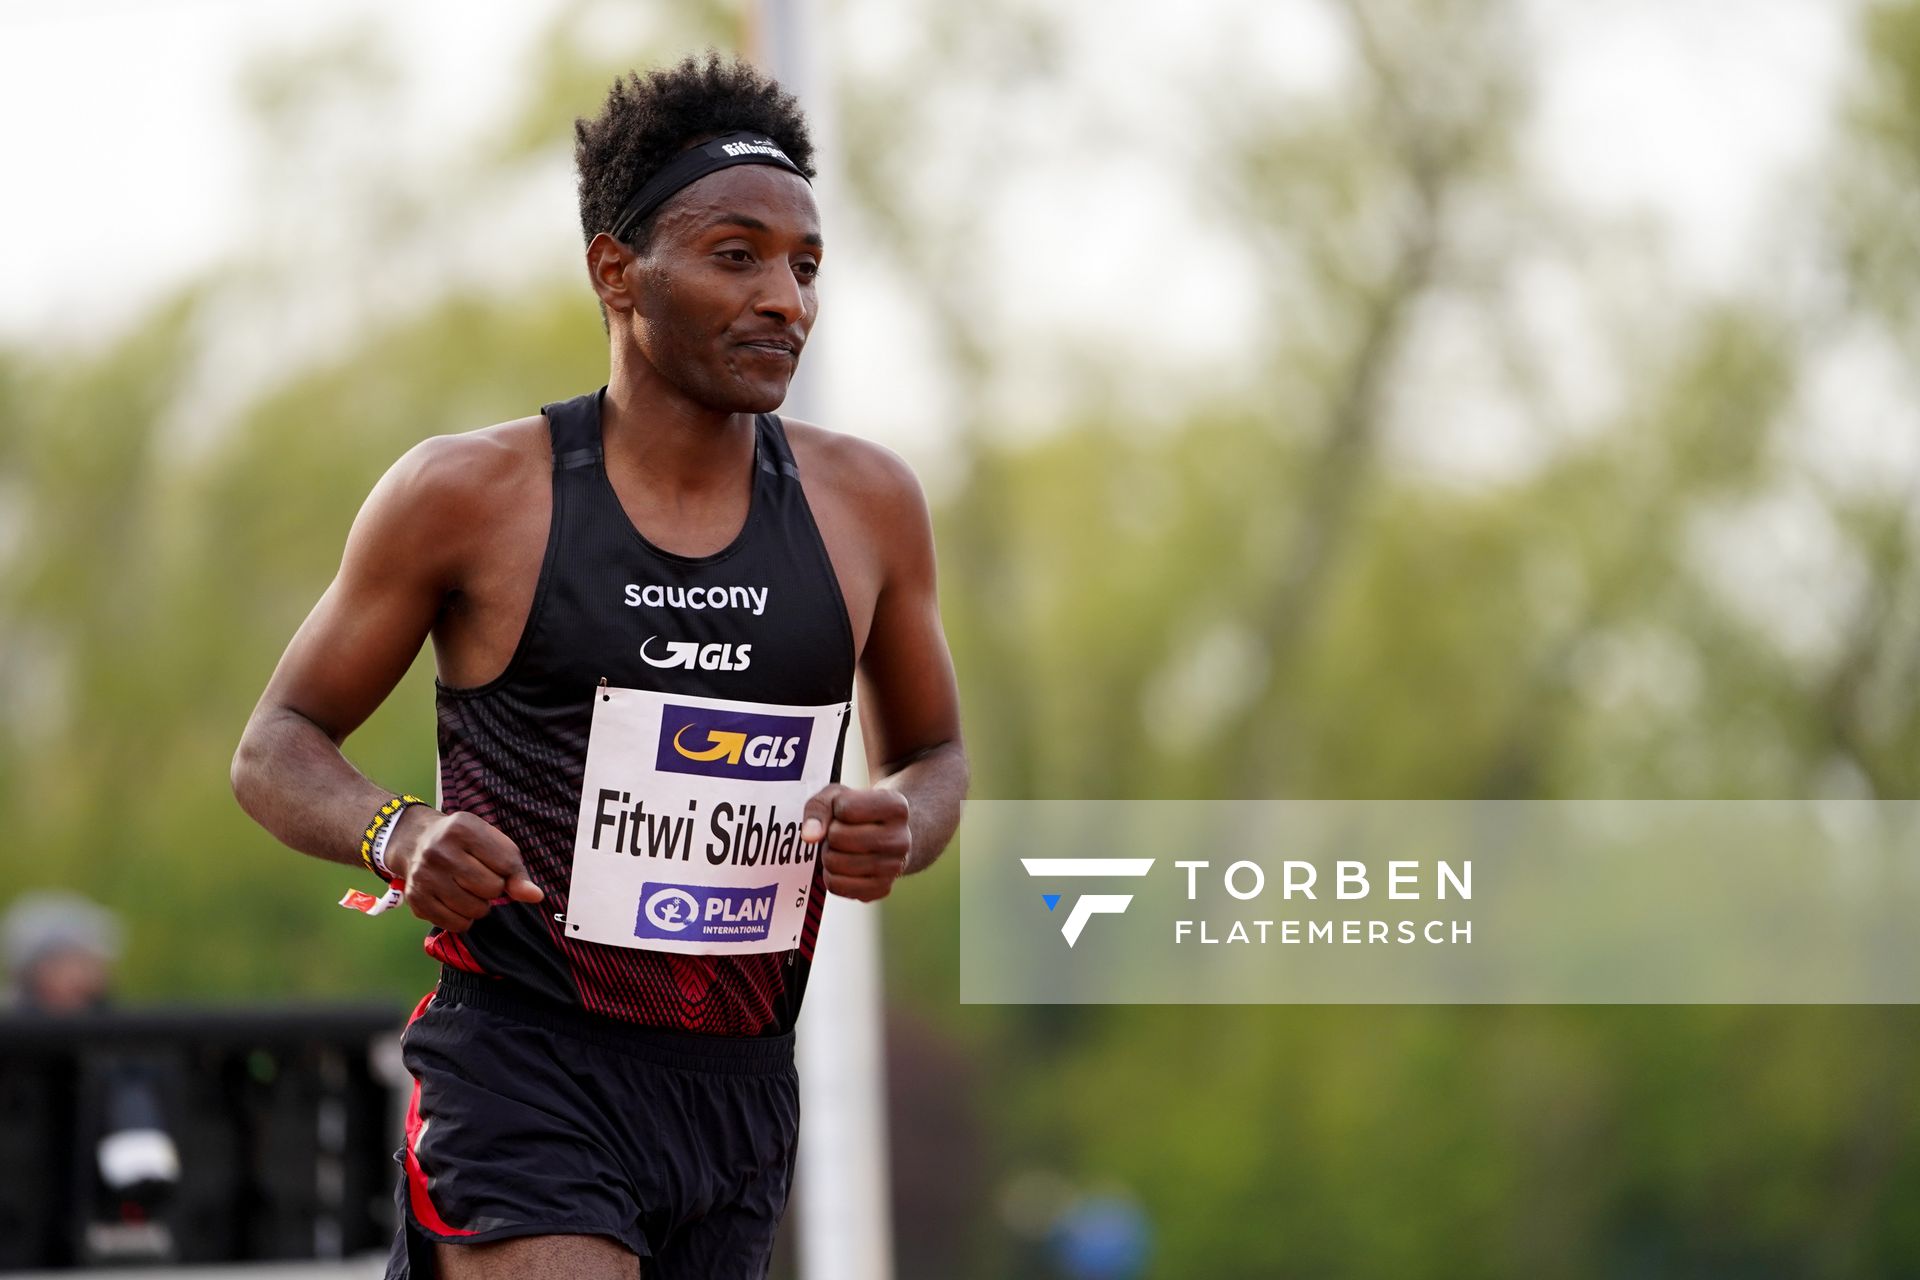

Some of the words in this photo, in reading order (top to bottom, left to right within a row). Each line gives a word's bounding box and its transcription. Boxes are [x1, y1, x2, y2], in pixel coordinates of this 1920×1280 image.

[624, 584, 768, 616] saucony
[699, 643, 752, 671] GLS
[744, 735, 800, 768] GLS
[592, 788, 697, 861] Fitwi
[704, 897, 771, 922] PLAN
[703, 925, 765, 935] INTERNATIONAL
